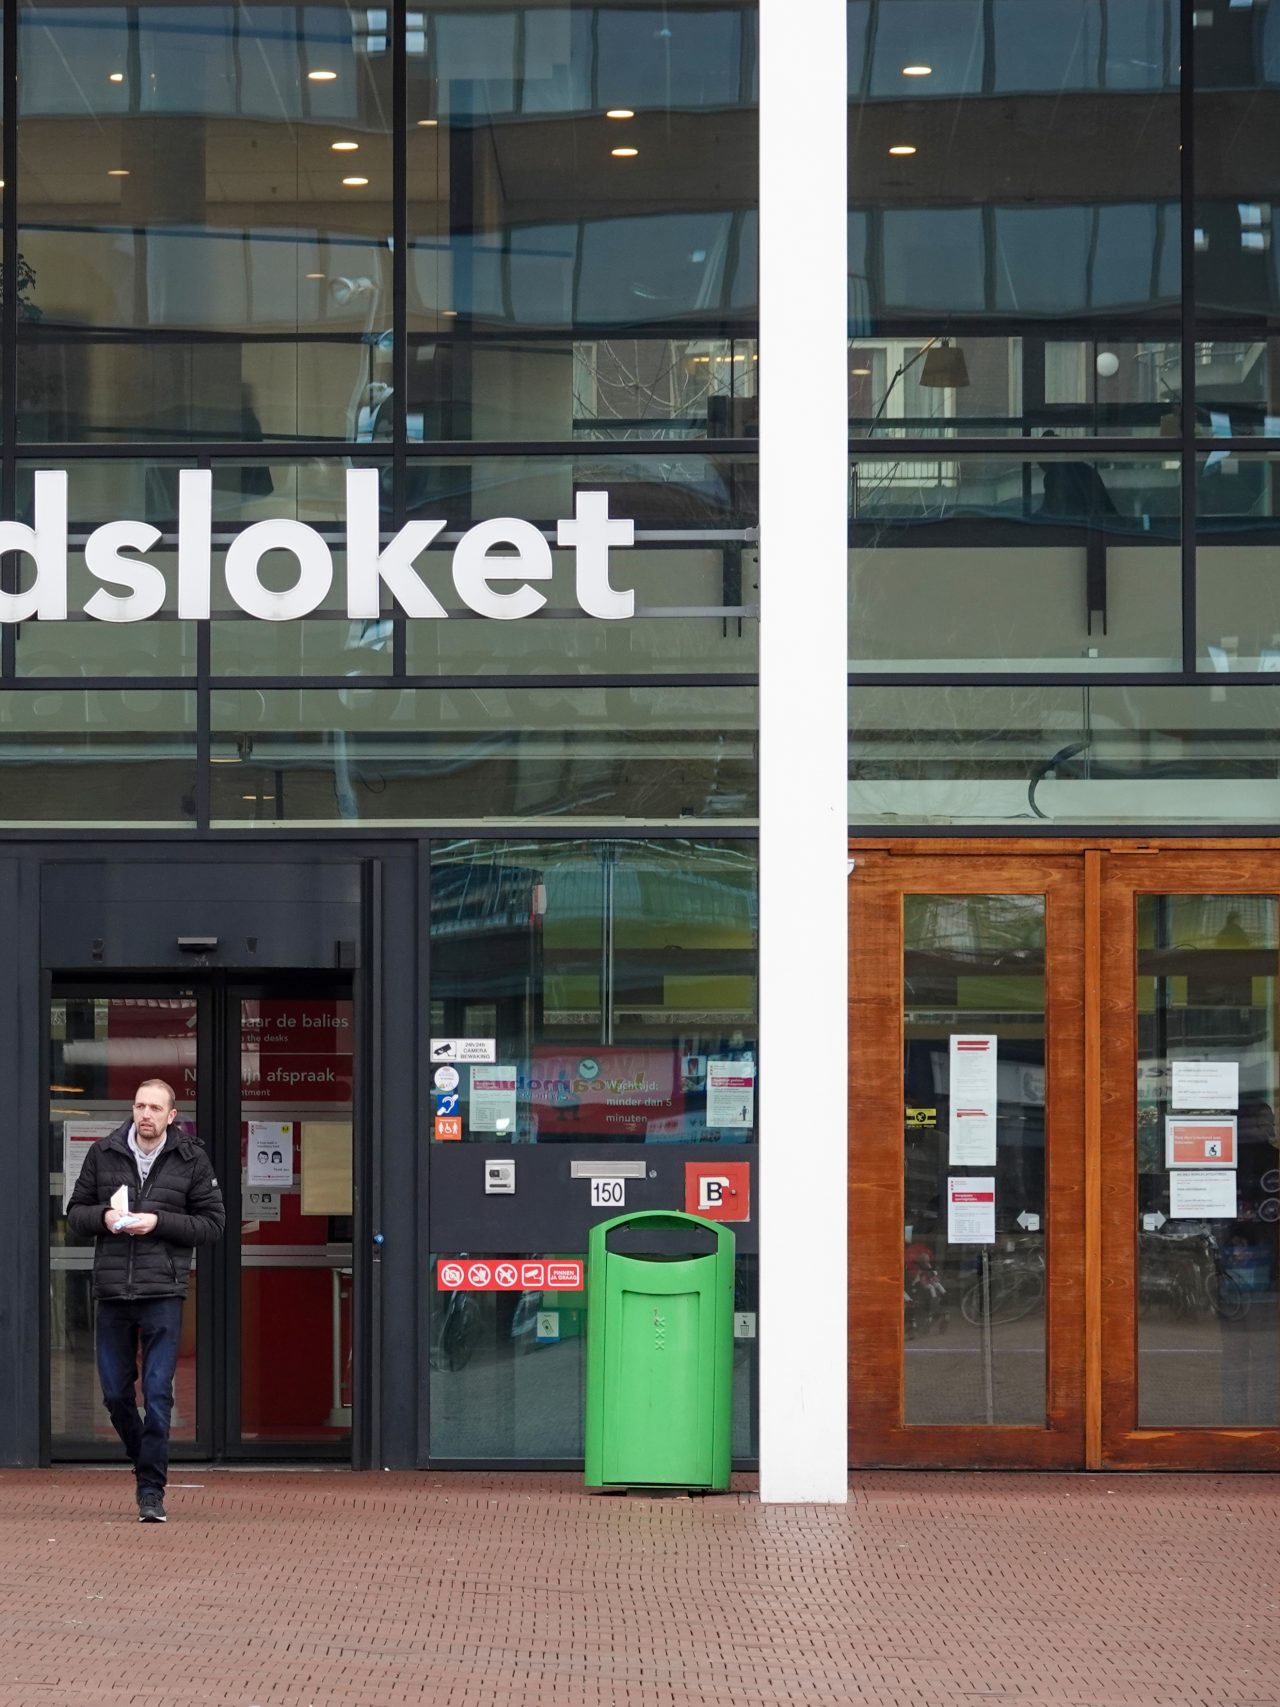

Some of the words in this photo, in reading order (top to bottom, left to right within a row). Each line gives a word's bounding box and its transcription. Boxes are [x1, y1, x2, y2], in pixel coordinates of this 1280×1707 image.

[276, 1013, 297, 1028] de
[302, 1013, 350, 1028] balies
[246, 1033, 262, 1042] the
[263, 1033, 289, 1043] desks
[266, 1067, 336, 1086] afspraak
[606, 1097, 642, 1107] minder
[644, 1097, 664, 1107] dan
[666, 1098, 672, 1107] 5
[606, 1113, 648, 1123] minuten
[593, 1182, 623, 1203] 150
[706, 1181, 723, 1202] B
